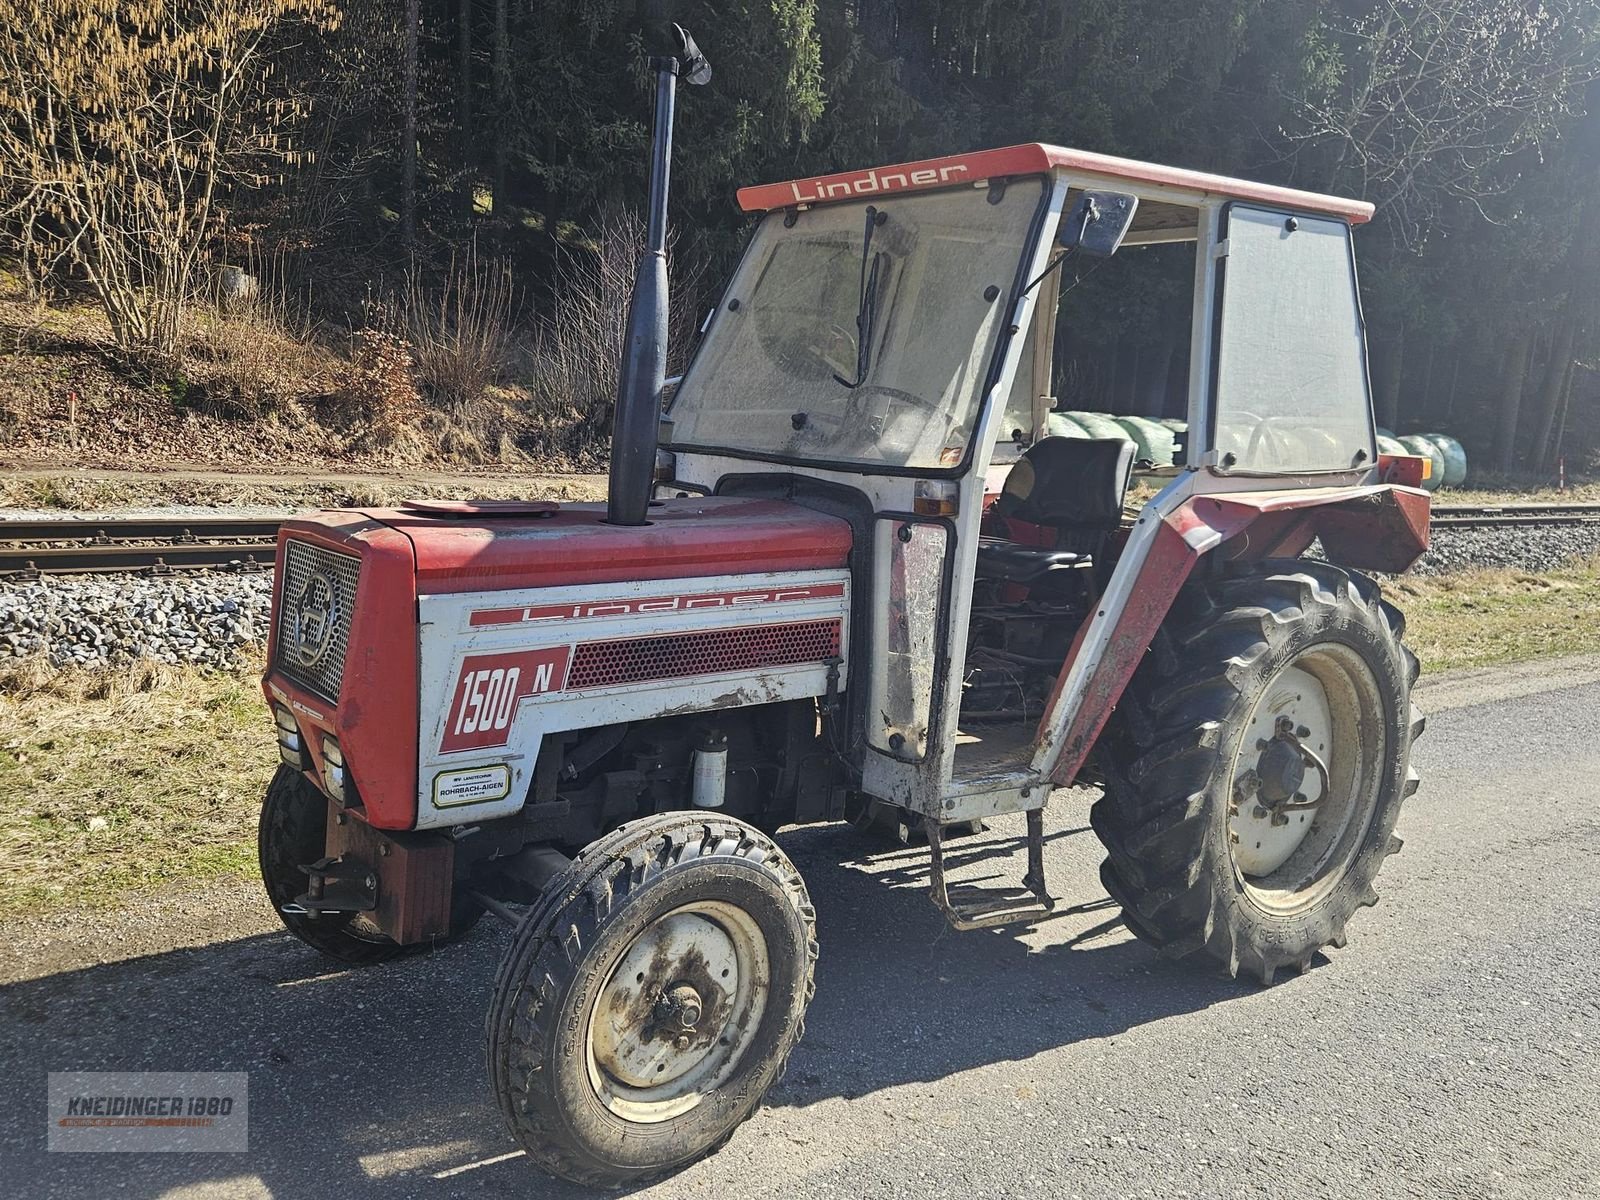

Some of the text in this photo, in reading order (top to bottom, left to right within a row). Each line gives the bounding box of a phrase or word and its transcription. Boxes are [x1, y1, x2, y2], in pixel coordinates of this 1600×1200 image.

[791, 164, 967, 202] Lindner
[521, 591, 811, 622] Lindner
[454, 663, 554, 736] 1500 N
[440, 782, 504, 796] ROHRBACH-AIGEN
